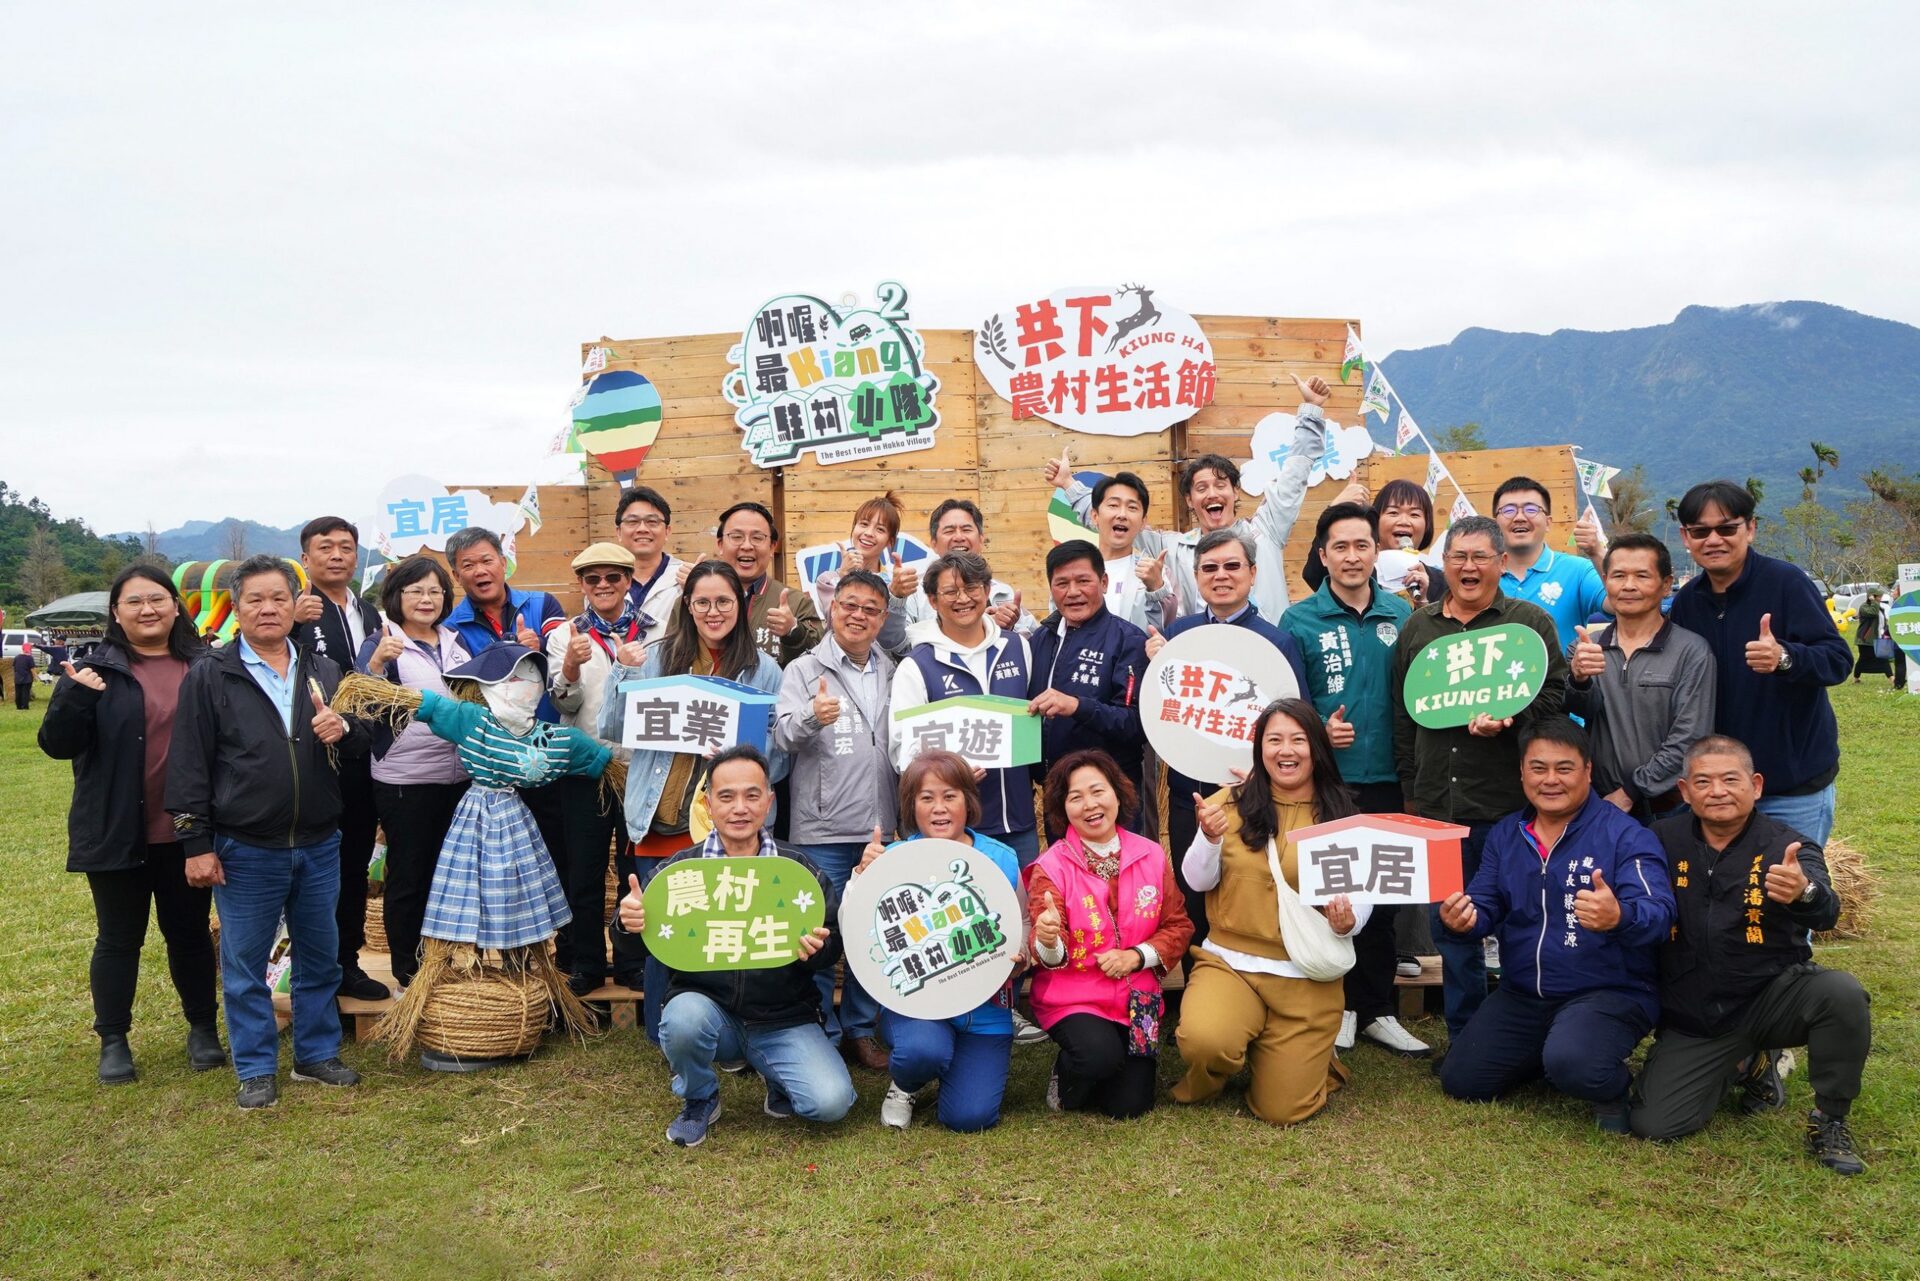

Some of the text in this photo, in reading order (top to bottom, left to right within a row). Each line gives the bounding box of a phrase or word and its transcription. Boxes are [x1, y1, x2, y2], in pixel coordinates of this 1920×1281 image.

[877, 282, 909, 320] 2
[1016, 295, 1111, 367] 共下
[1119, 332, 1205, 358] KIUNG HA
[773, 383, 922, 442] 駐村小隊
[1009, 358, 1216, 421] 農村生活節
[835, 449, 852, 457] Best
[853, 446, 873, 454] Team
[906, 437, 931, 446] Village
[387, 495, 469, 539] 宜居
[1318, 631, 1345, 694] 黃治維
[1446, 633, 1507, 685] 共下
[1180, 665, 1232, 702] 共下
[1415, 682, 1531, 714] KIUNG HA
[636, 697, 730, 747] 宜業
[1247, 704, 1266, 713] KIU
[912, 718, 1003, 761] 宜遊
[666, 866, 759, 917] 農村
[949, 858, 974, 884] 2
[1310, 843, 1416, 897] 宜居
[1676, 860, 1689, 888] 特助
[702, 915, 792, 963] 再生
[1082, 894, 1104, 947] 理事長
[902, 919, 996, 981] 駐村小隊
[958, 967, 970, 975] Team
